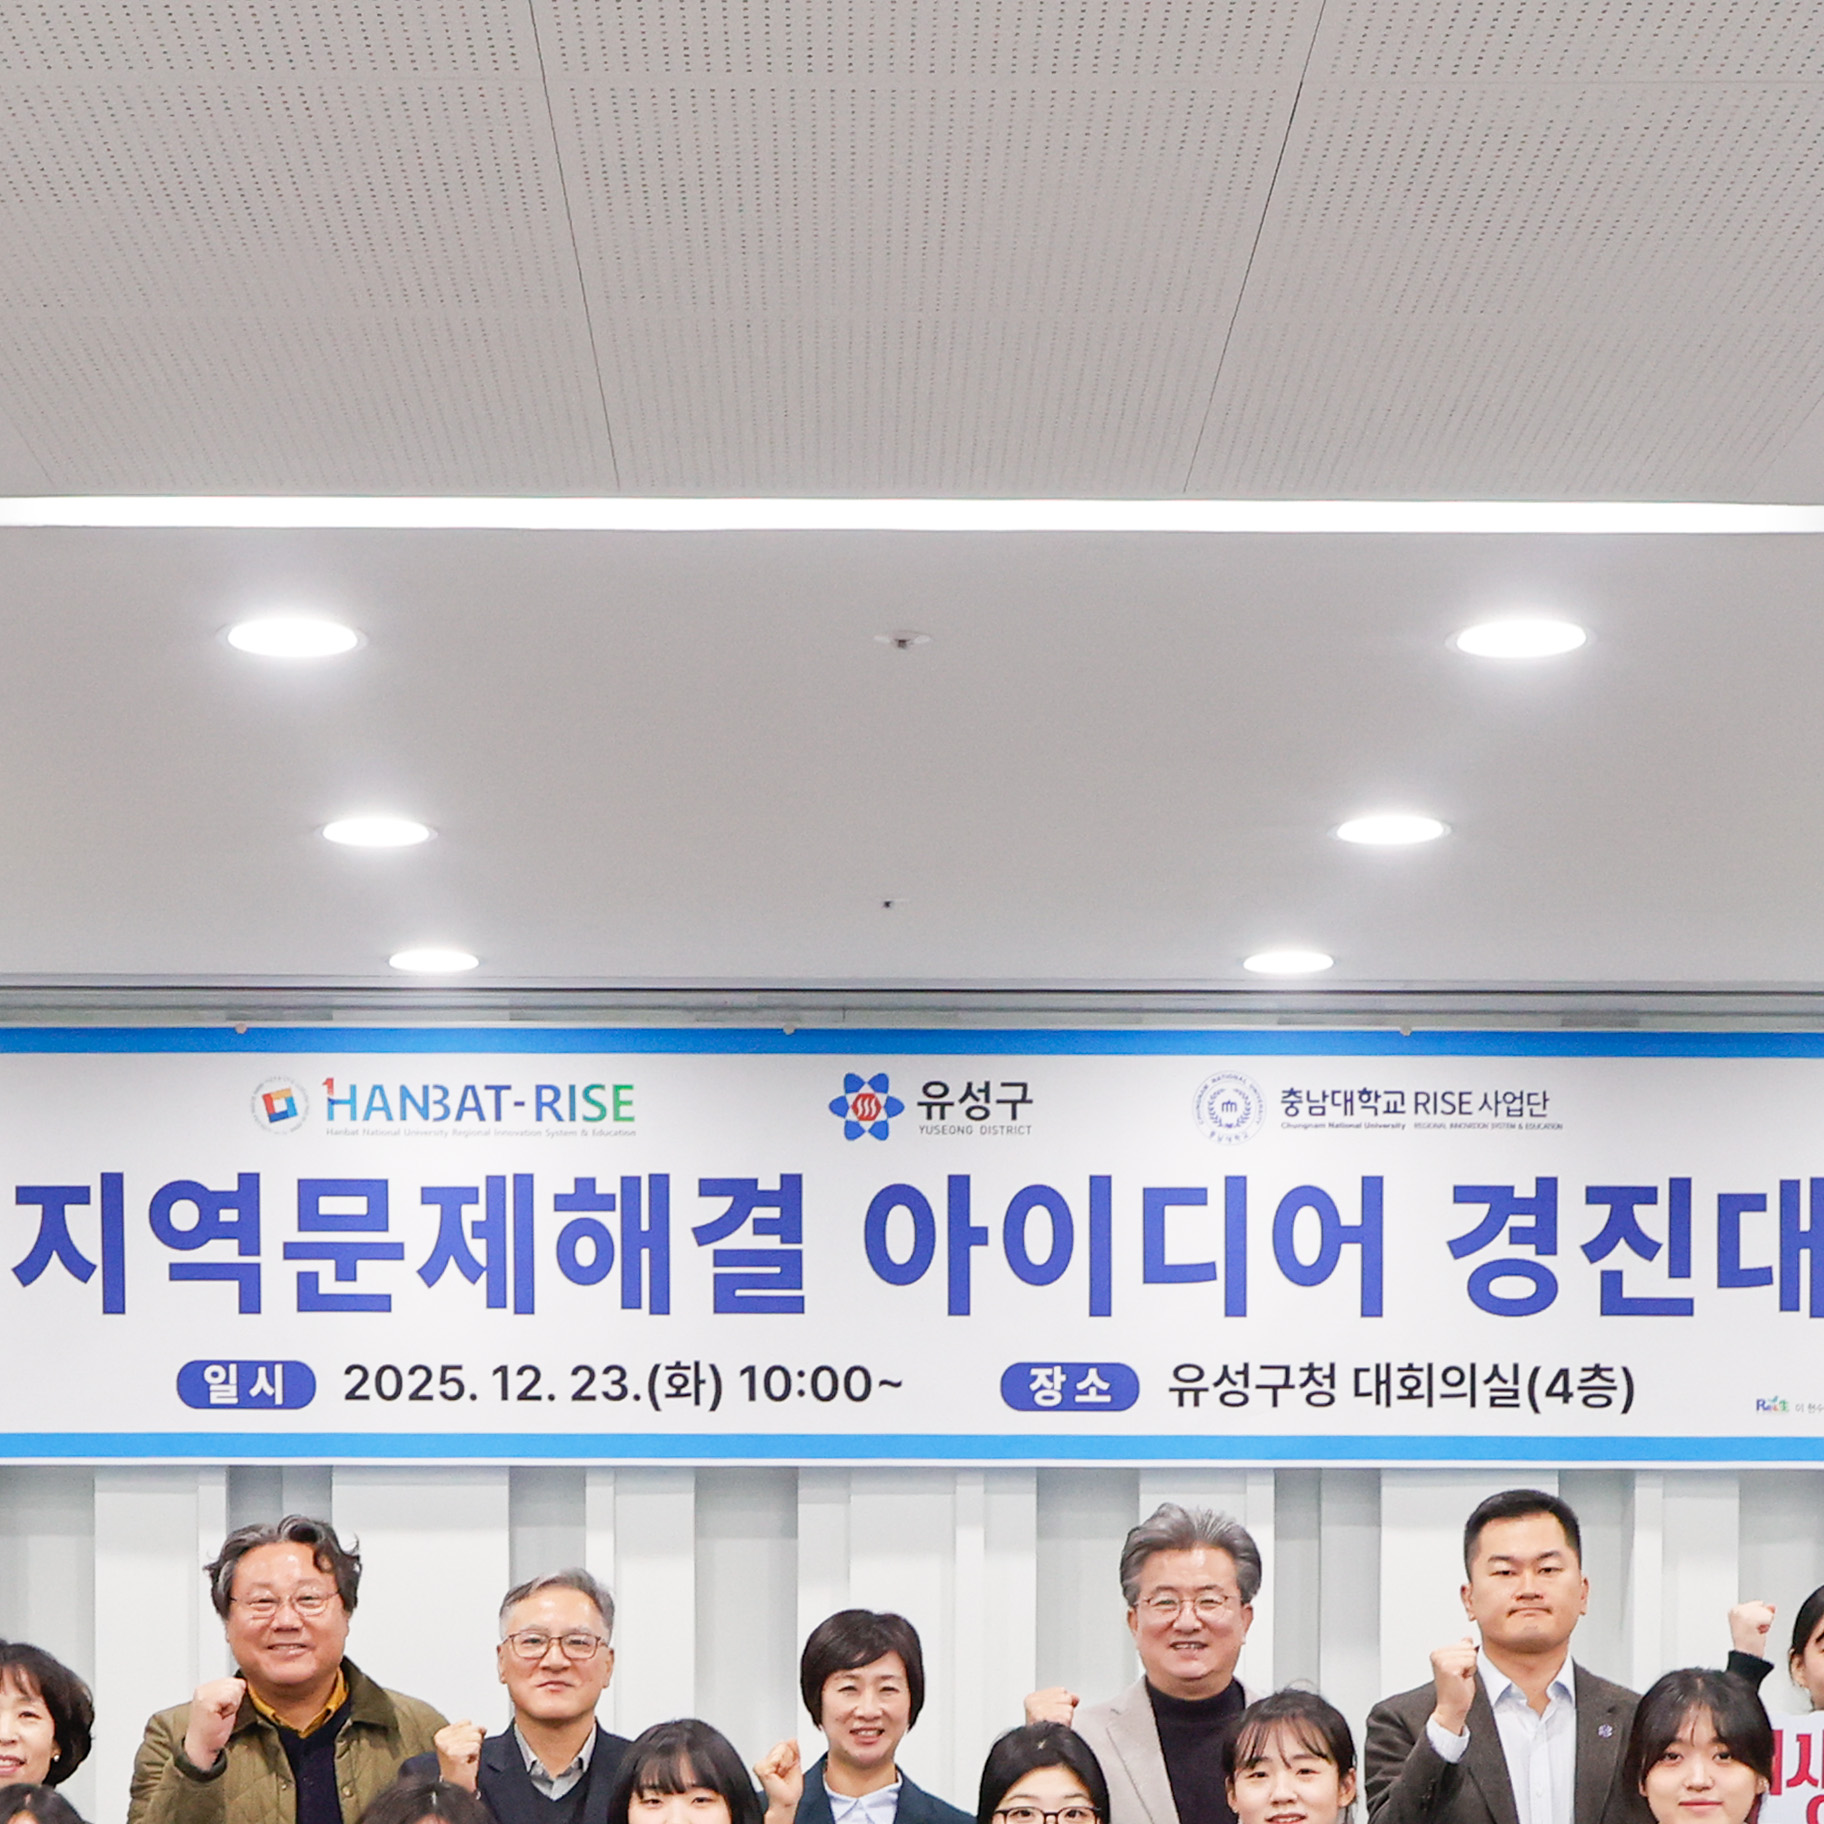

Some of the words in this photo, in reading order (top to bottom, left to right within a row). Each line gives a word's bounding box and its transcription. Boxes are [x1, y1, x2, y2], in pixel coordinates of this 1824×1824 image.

[916, 1080, 1034, 1122] 유성구
[1280, 1087, 1406, 1118] 충남대학교
[1414, 1090, 1473, 1116] RISE
[1478, 1089, 1550, 1118] 사업단
[918, 1124, 974, 1136] YUSEONG
[979, 1124, 1032, 1136] DISTRICT
[10, 1171, 806, 1316] 지역문제해결
[863, 1173, 1384, 1318] 아이디어
[202, 1360, 286, 1406] 일시
[344, 1363, 478, 1402] 2025.
[492, 1364, 556, 1402] 12.
[570, 1360, 723, 1412] 23.(화)
[739, 1364, 903, 1403] 10:00~
[1026, 1360, 1116, 1408] 장소
[1168, 1361, 1336, 1408] 유성구청
[1353, 1362, 1635, 1415] 대회의실(4층)
